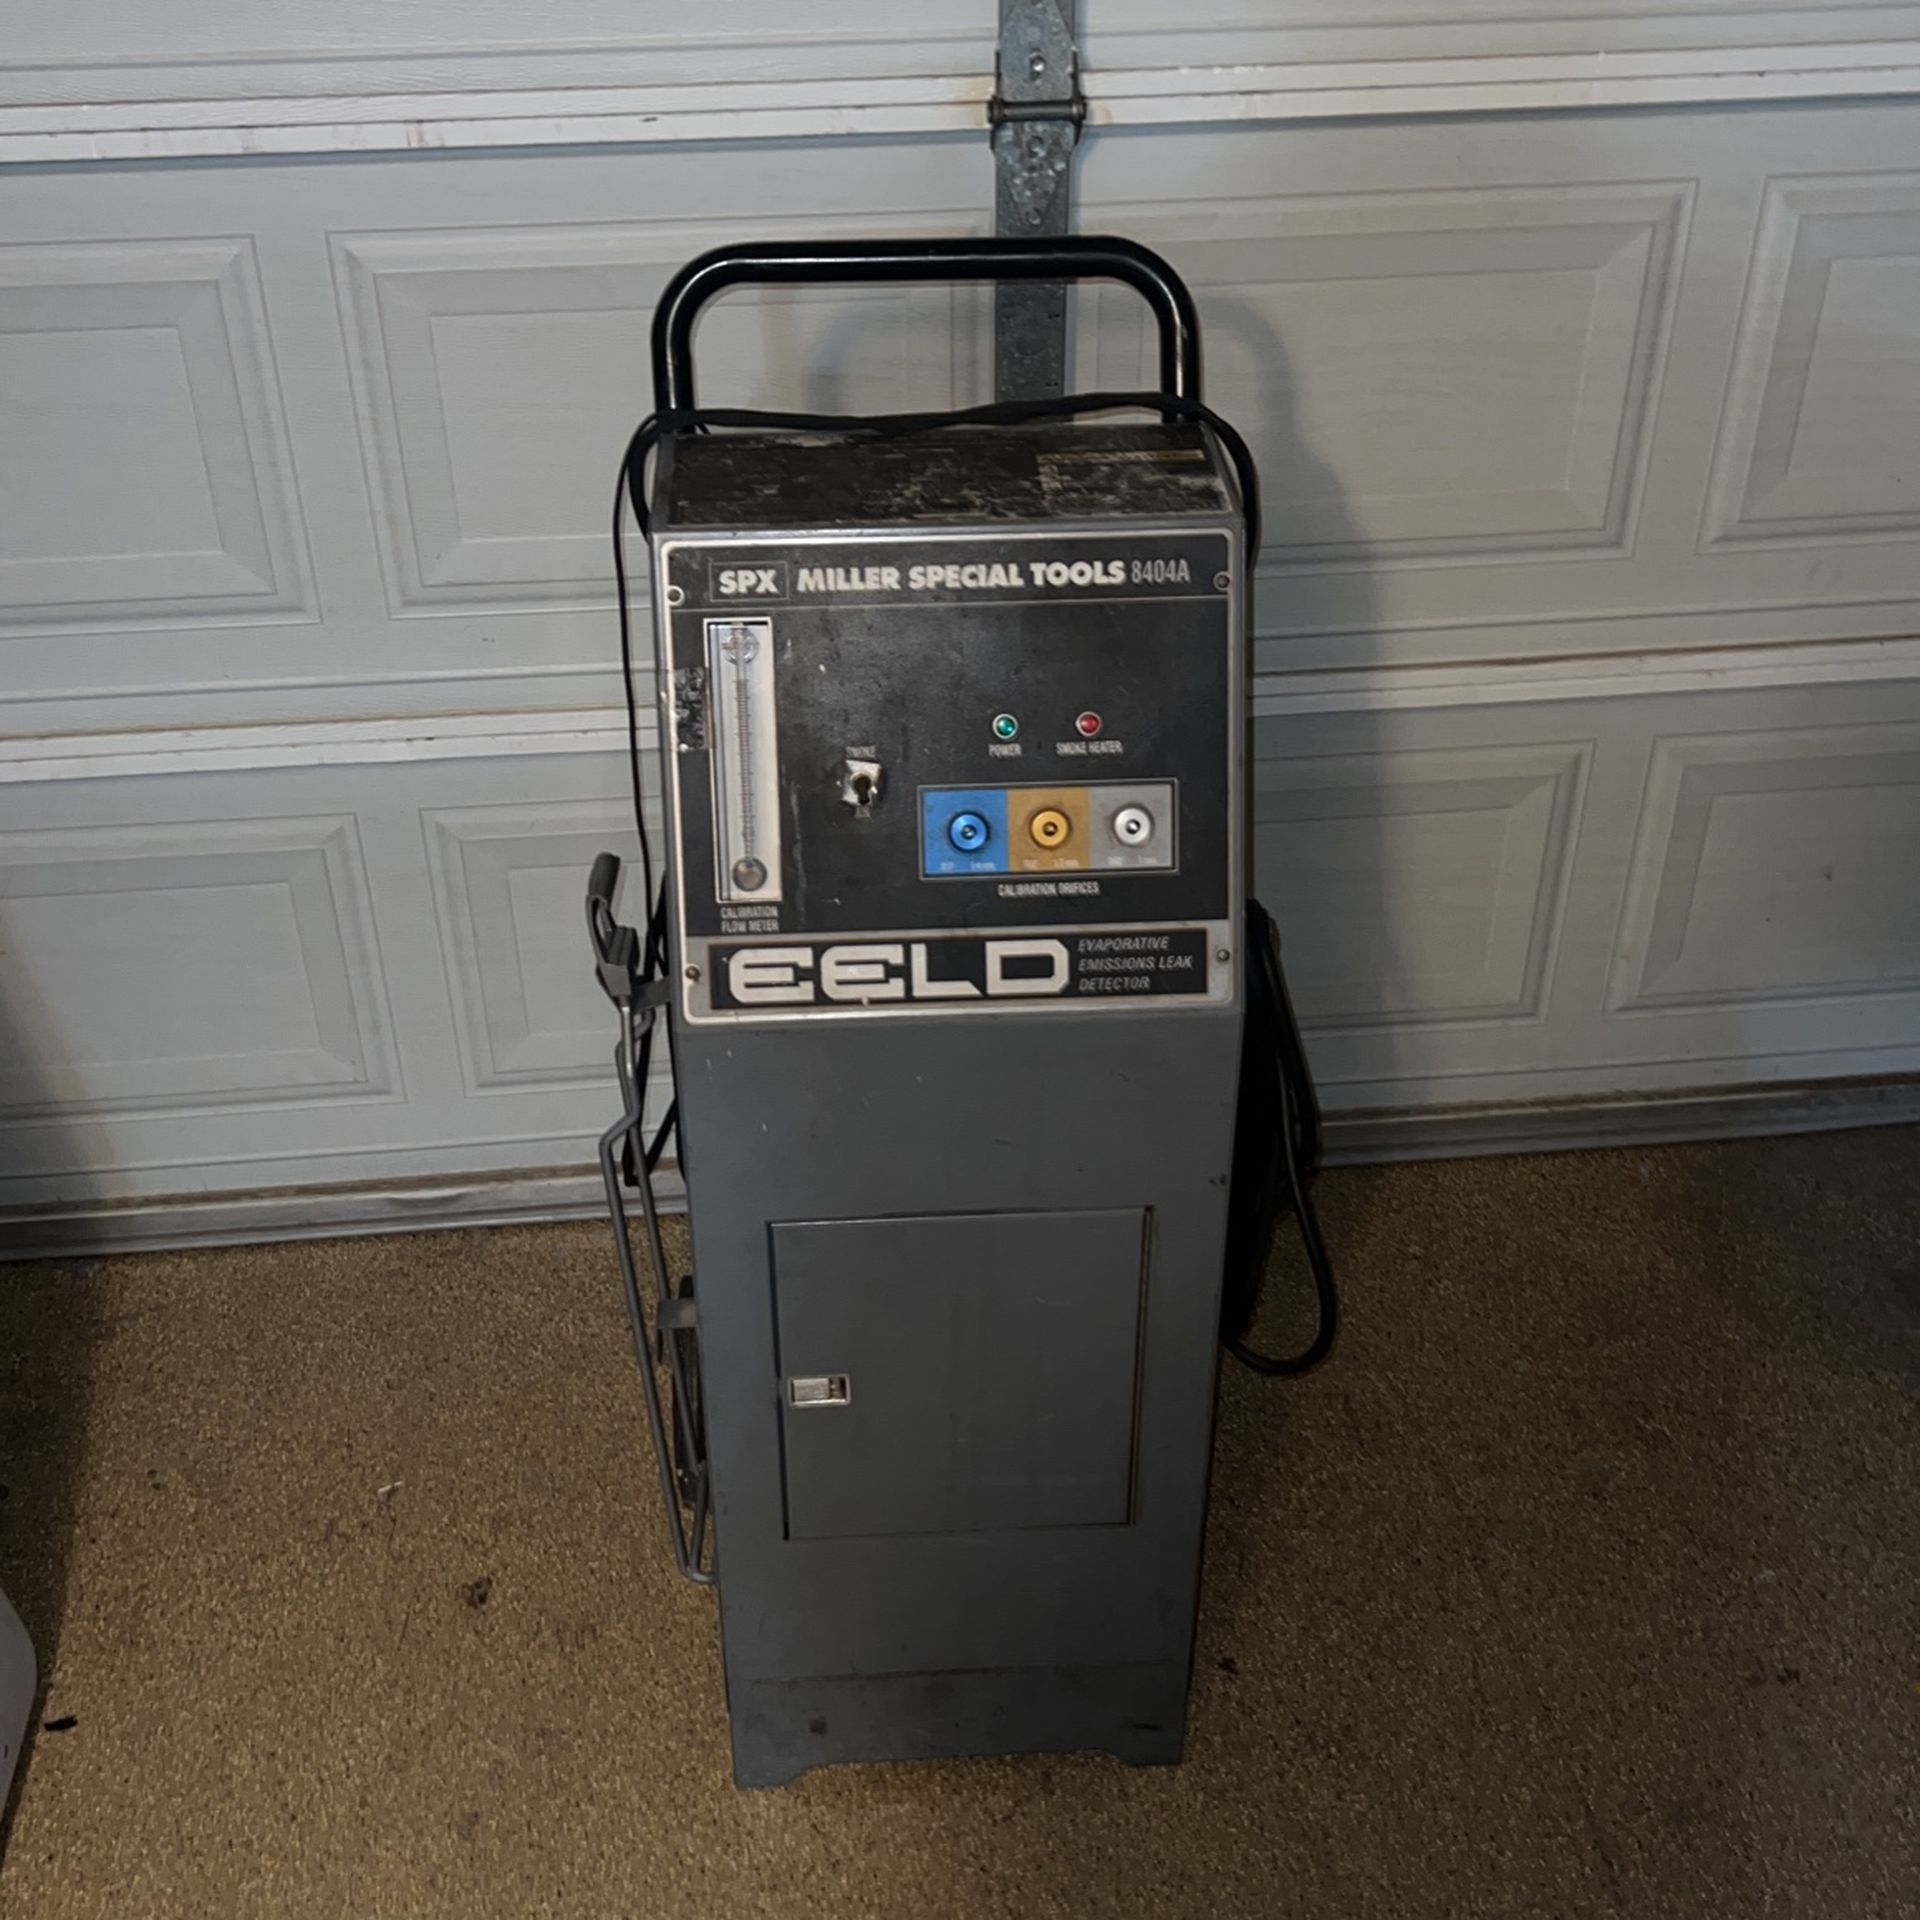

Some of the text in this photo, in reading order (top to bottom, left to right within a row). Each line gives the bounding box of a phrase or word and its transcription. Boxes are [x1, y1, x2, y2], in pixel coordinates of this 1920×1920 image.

[719, 569, 778, 594] SPX
[797, 559, 1191, 592] MILLER SPECIAL TOOLS 8404A
[988, 743, 1022, 757] POWER
[1055, 740, 1124, 756] SMOKE HEATER
[998, 880, 1100, 898] CALIBRATION ORIFICES
[720, 906, 779, 919] CALIBRATION
[721, 919, 780, 933] FLOW METER
[1078, 936, 1170, 951] EVAPORATIVE
[728, 939, 1070, 1004] EELD
[1078, 955, 1193, 972] EMISSIONS LEAK
[1078, 976, 1150, 991] DETECTOR
